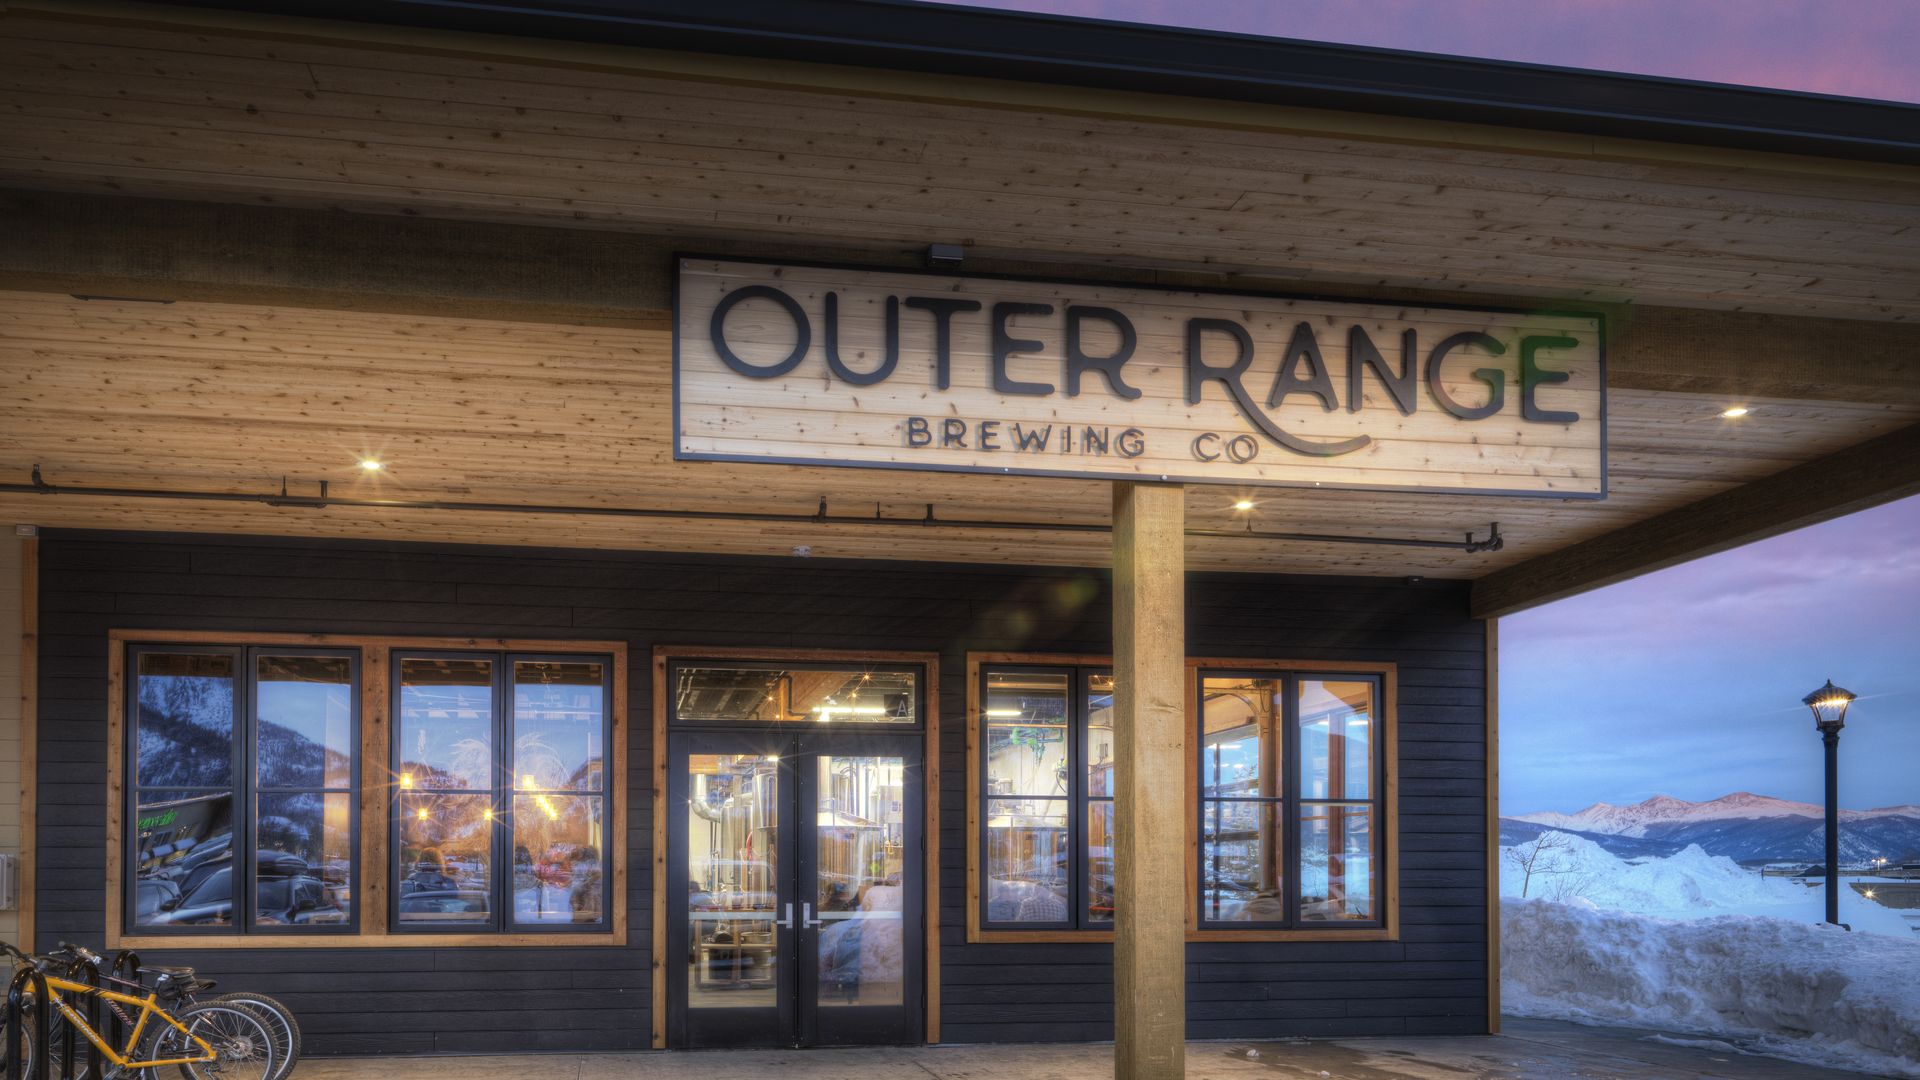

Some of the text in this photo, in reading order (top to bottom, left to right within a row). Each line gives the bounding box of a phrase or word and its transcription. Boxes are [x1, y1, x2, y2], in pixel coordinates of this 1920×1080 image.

[709, 284, 1580, 457] OUTER RANGE
[908, 416, 1260, 464] BREWING CO
[896, 699, 908, 718] A
